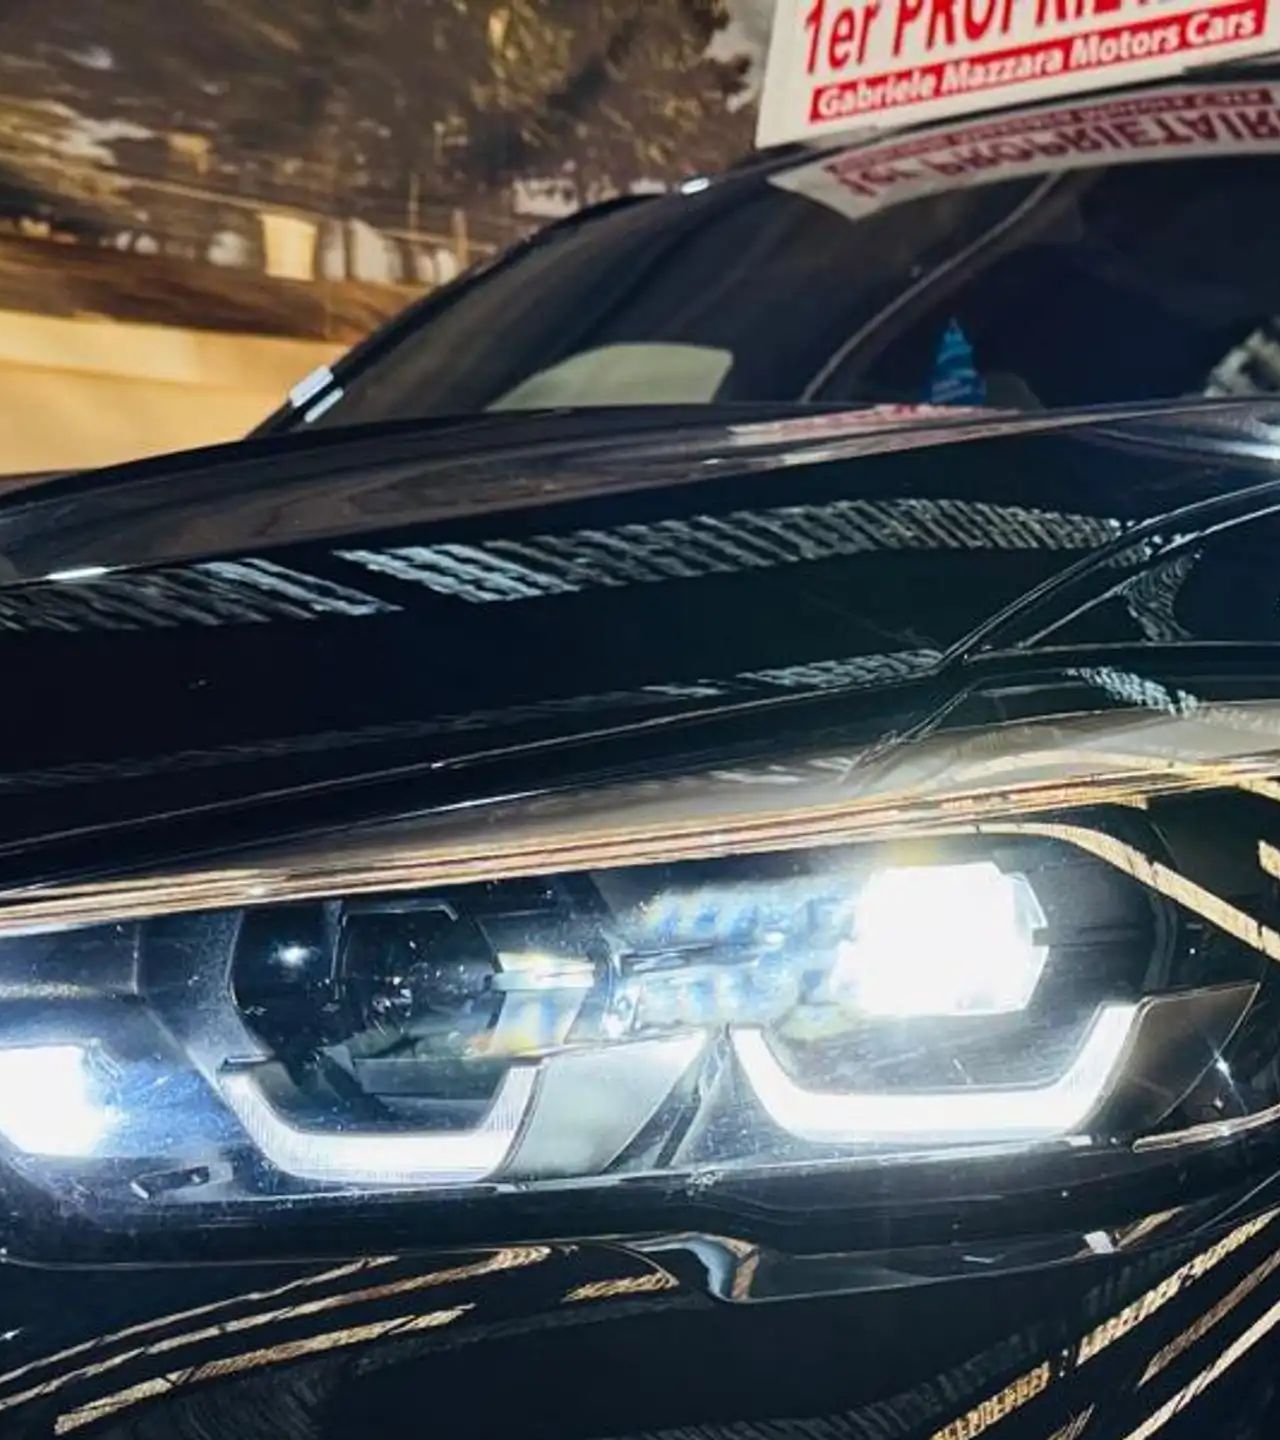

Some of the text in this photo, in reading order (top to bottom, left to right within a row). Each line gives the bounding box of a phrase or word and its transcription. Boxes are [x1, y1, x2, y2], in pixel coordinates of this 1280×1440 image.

[804, 0, 881, 75] 1er
[818, 70, 939, 117] Gabriele
[940, 47, 1065, 93] Mazzara
[1070, 23, 1181, 68] Motors
[1185, 9, 1257, 46] Cars
